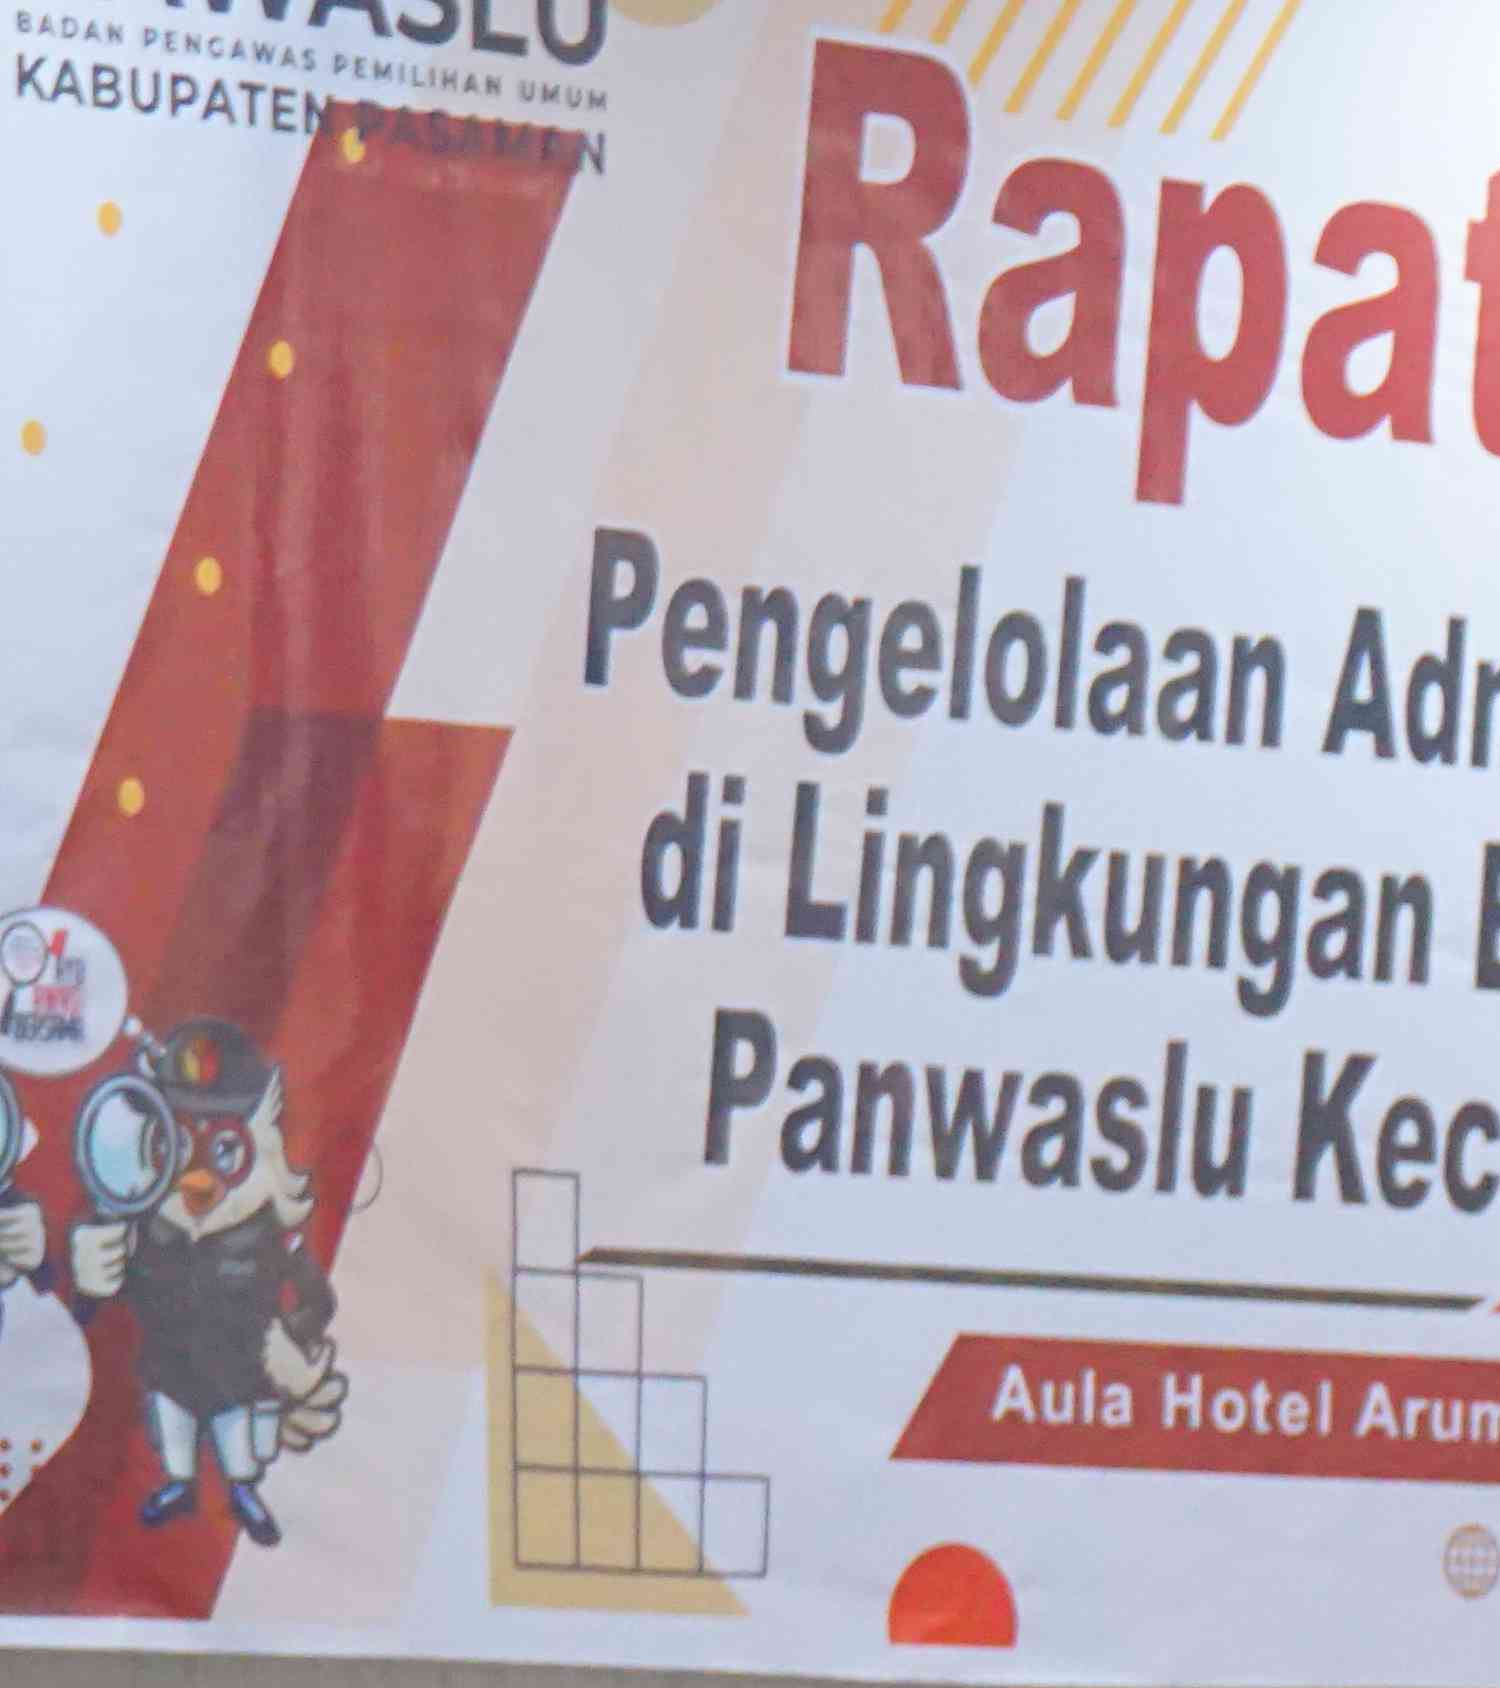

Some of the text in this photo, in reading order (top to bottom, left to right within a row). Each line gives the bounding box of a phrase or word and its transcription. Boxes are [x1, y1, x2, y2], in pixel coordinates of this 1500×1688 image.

[15, 53, 333, 136] KABUPATEN
[16, 10, 124, 44] BADAN
[333, 53, 502, 96] PEMILIHAN
[518, 80, 608, 111] UMUM
[584, 525, 1285, 754] Pengelolaan
[639, 771, 746, 933] di
[784, 781, 1433, 1017] Lingkungan
[702, 1006, 1252, 1200] Panwaslu
[992, 1364, 1133, 1428] Aula
[1162, 1373, 1331, 1436] Hotel
